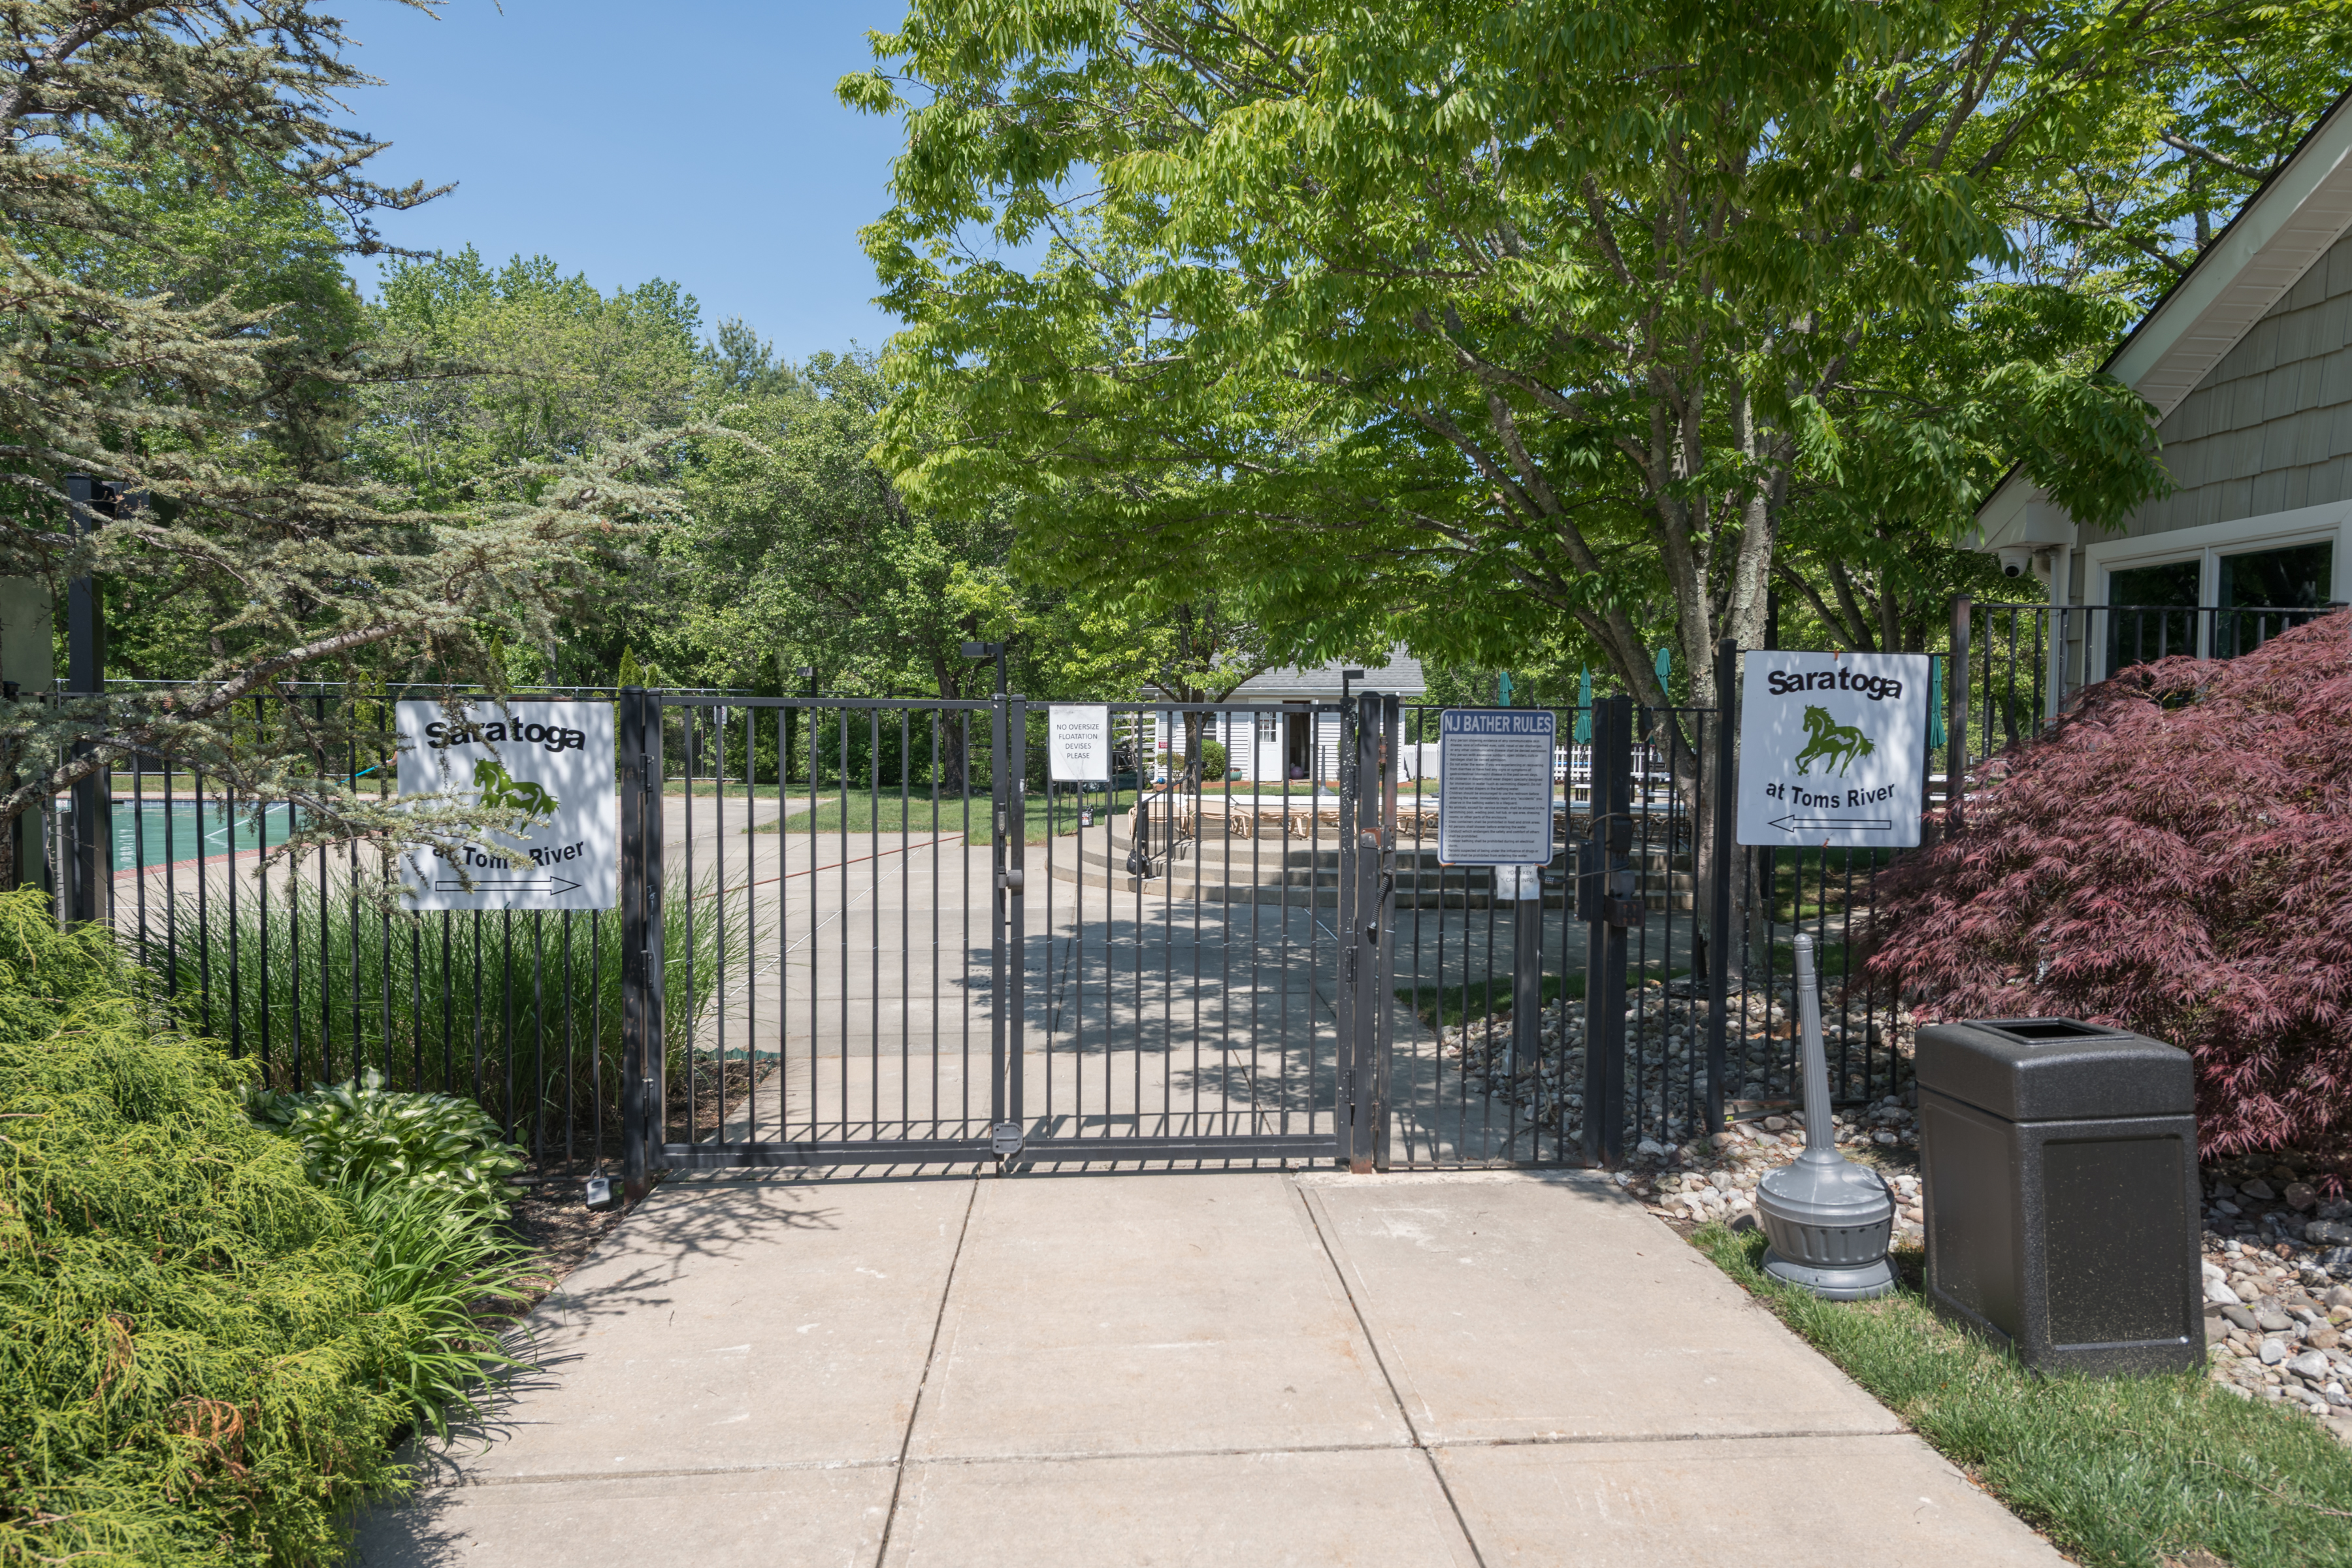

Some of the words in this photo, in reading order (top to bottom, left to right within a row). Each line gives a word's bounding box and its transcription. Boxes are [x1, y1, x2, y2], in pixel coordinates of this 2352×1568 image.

[1768, 666, 1903, 700] Saratoga
[1445, 715, 1460, 731] NJ
[1464, 715, 1511, 732] BATHER
[1513, 717, 1552, 732] RULES
[1766, 783, 1785, 800] at
[1791, 786, 1840, 808] Toms
[1848, 783, 1895, 808] River
[463, 846, 516, 869] Tom
[529, 841, 584, 867] River
